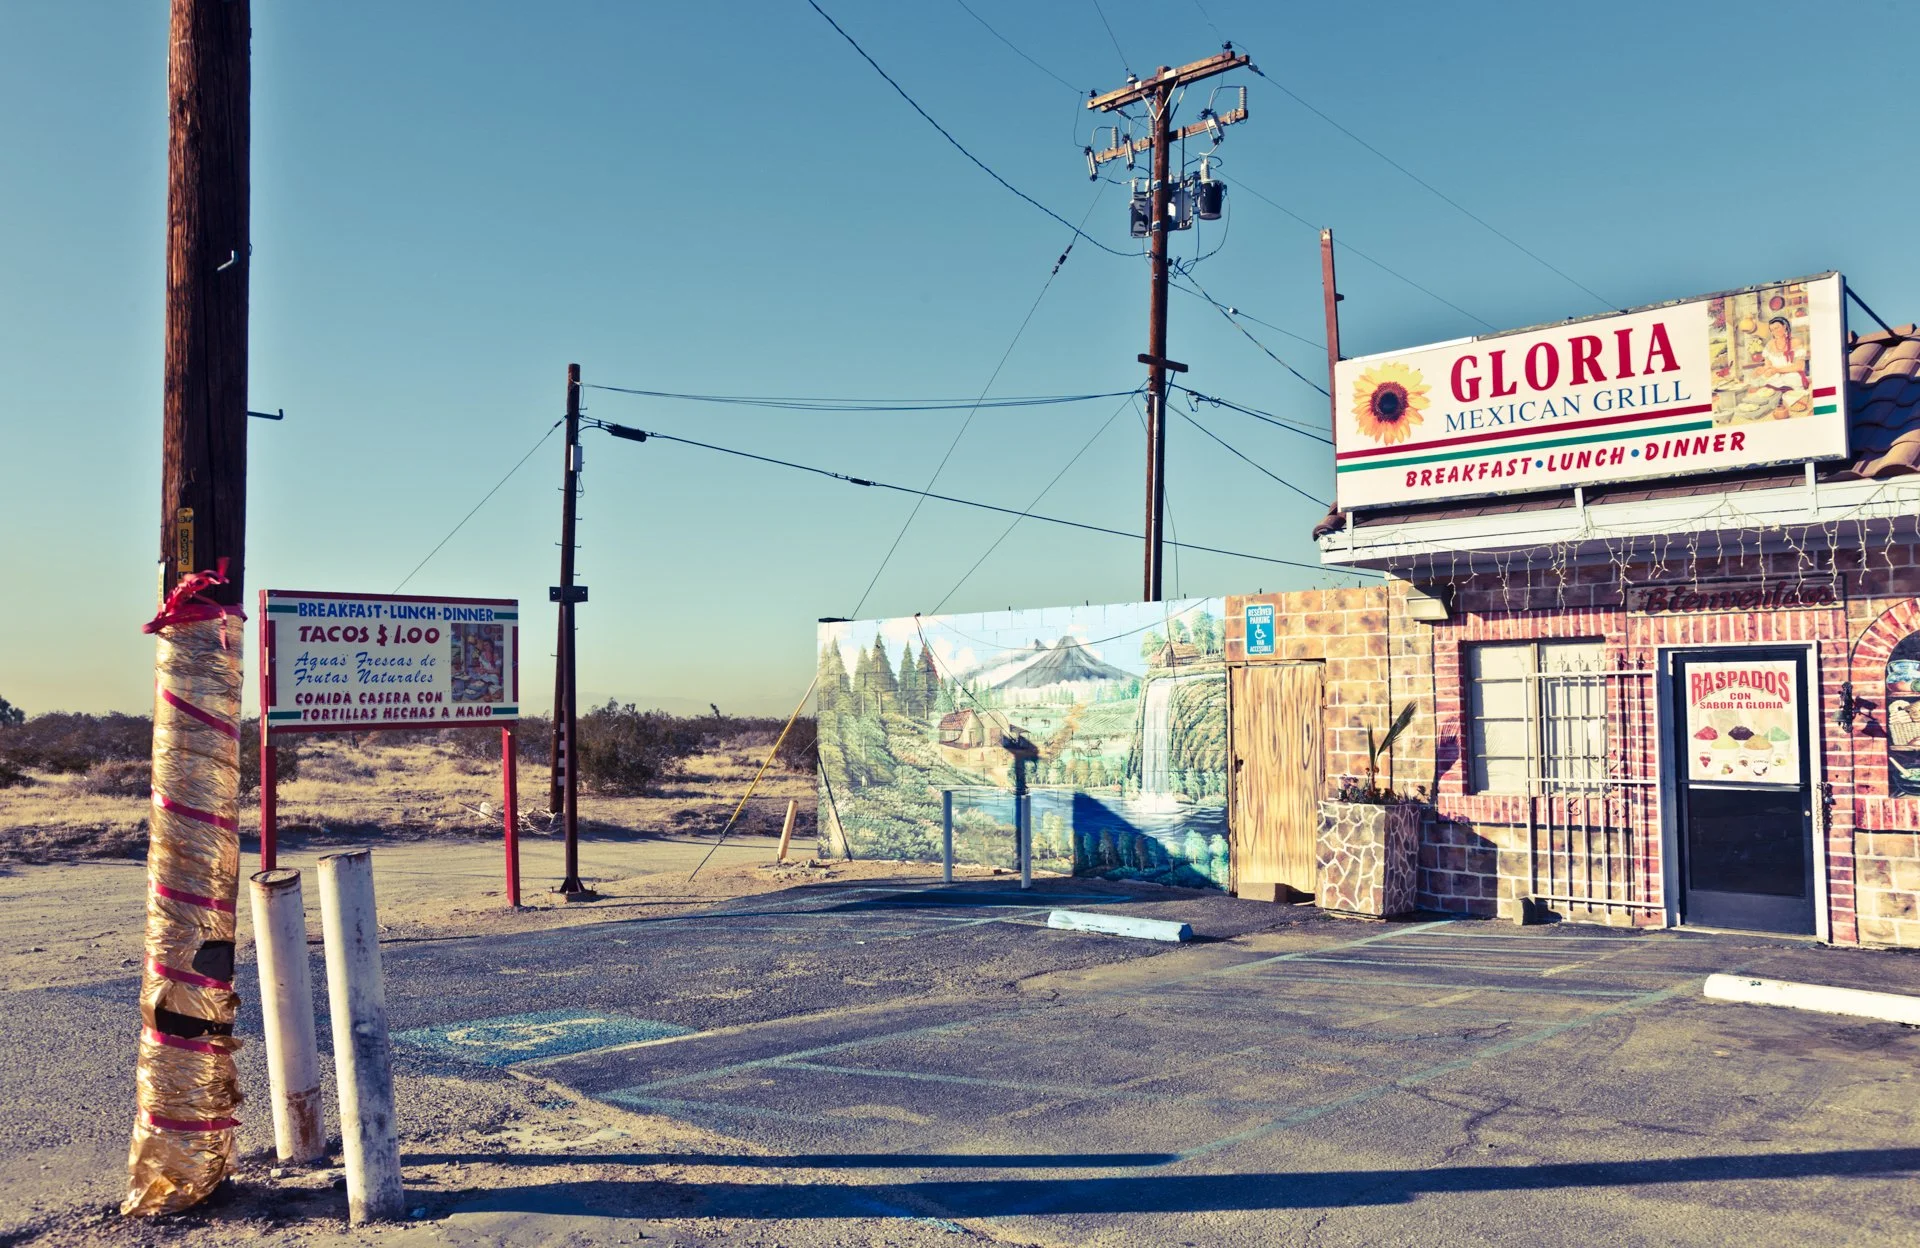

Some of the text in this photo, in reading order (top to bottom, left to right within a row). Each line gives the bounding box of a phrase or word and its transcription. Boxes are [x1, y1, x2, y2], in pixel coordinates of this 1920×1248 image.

[1450, 322, 1681, 403] GLORIA
[1446, 380, 1692, 433] MEXICAN GRILL
[1405, 431, 1747, 488] BREAKFAST LUNCH DINNER
[1645, 581, 1838, 615] Bienvenidos
[298, 602, 494, 622] BREAKFAST LUNCH DINNER
[298, 625, 370, 643] TACOS
[294, 651, 436, 670] Aguas Frescas de
[294, 668, 433, 686] Frutas Naturales
[1691, 670, 1791, 706] RASPADOS
[1729, 692, 1751, 700] CON
[295, 691, 443, 706] COMIDA CASERA CON
[1700, 701, 1783, 709] SABOR A GLORIA
[302, 705, 492, 721] TORTILLAS HECHAS A MANO
